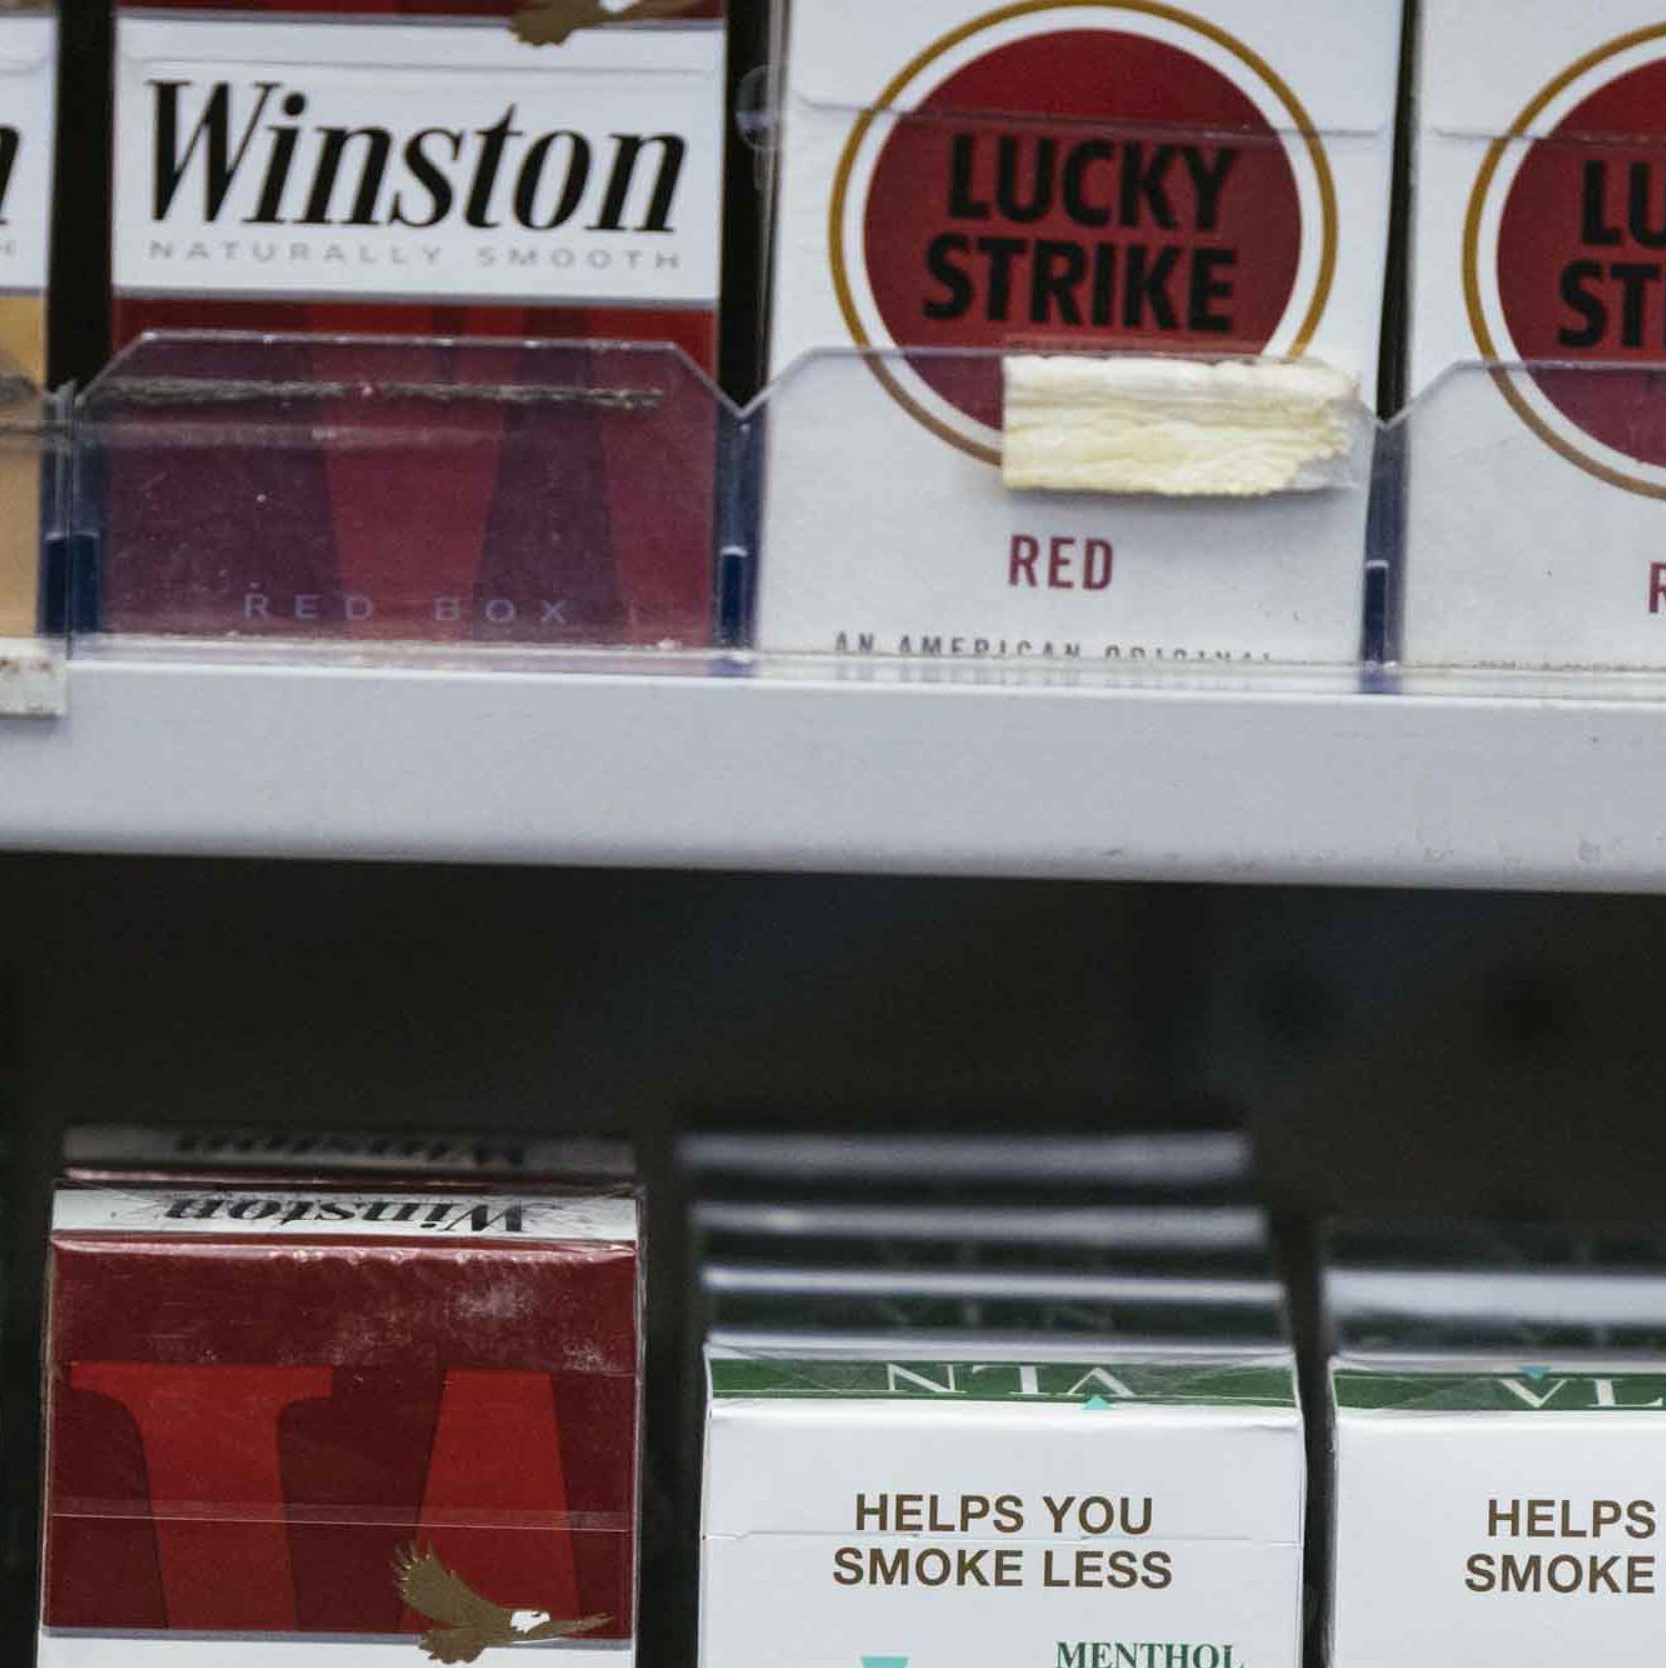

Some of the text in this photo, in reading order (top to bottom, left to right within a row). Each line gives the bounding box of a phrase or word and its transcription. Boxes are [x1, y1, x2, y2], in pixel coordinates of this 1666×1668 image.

[146, 79, 689, 233] Winston
[946, 133, 1243, 233] LUCKY
[149, 239, 681, 271] NATURALLY SMOOTH
[922, 232, 1239, 335] STRIKE
[1007, 533, 1115, 591] RED
[243, 595, 568, 624] RED BOX
[886, 1363, 1135, 1398] VLN
[854, 1492, 1154, 1535] HELPS YOU
[1486, 1499, 1656, 1540] HELPS
[832, 1546, 1173, 1590] SMOKE LESS
[1464, 1553, 1655, 1594] SMOKE
